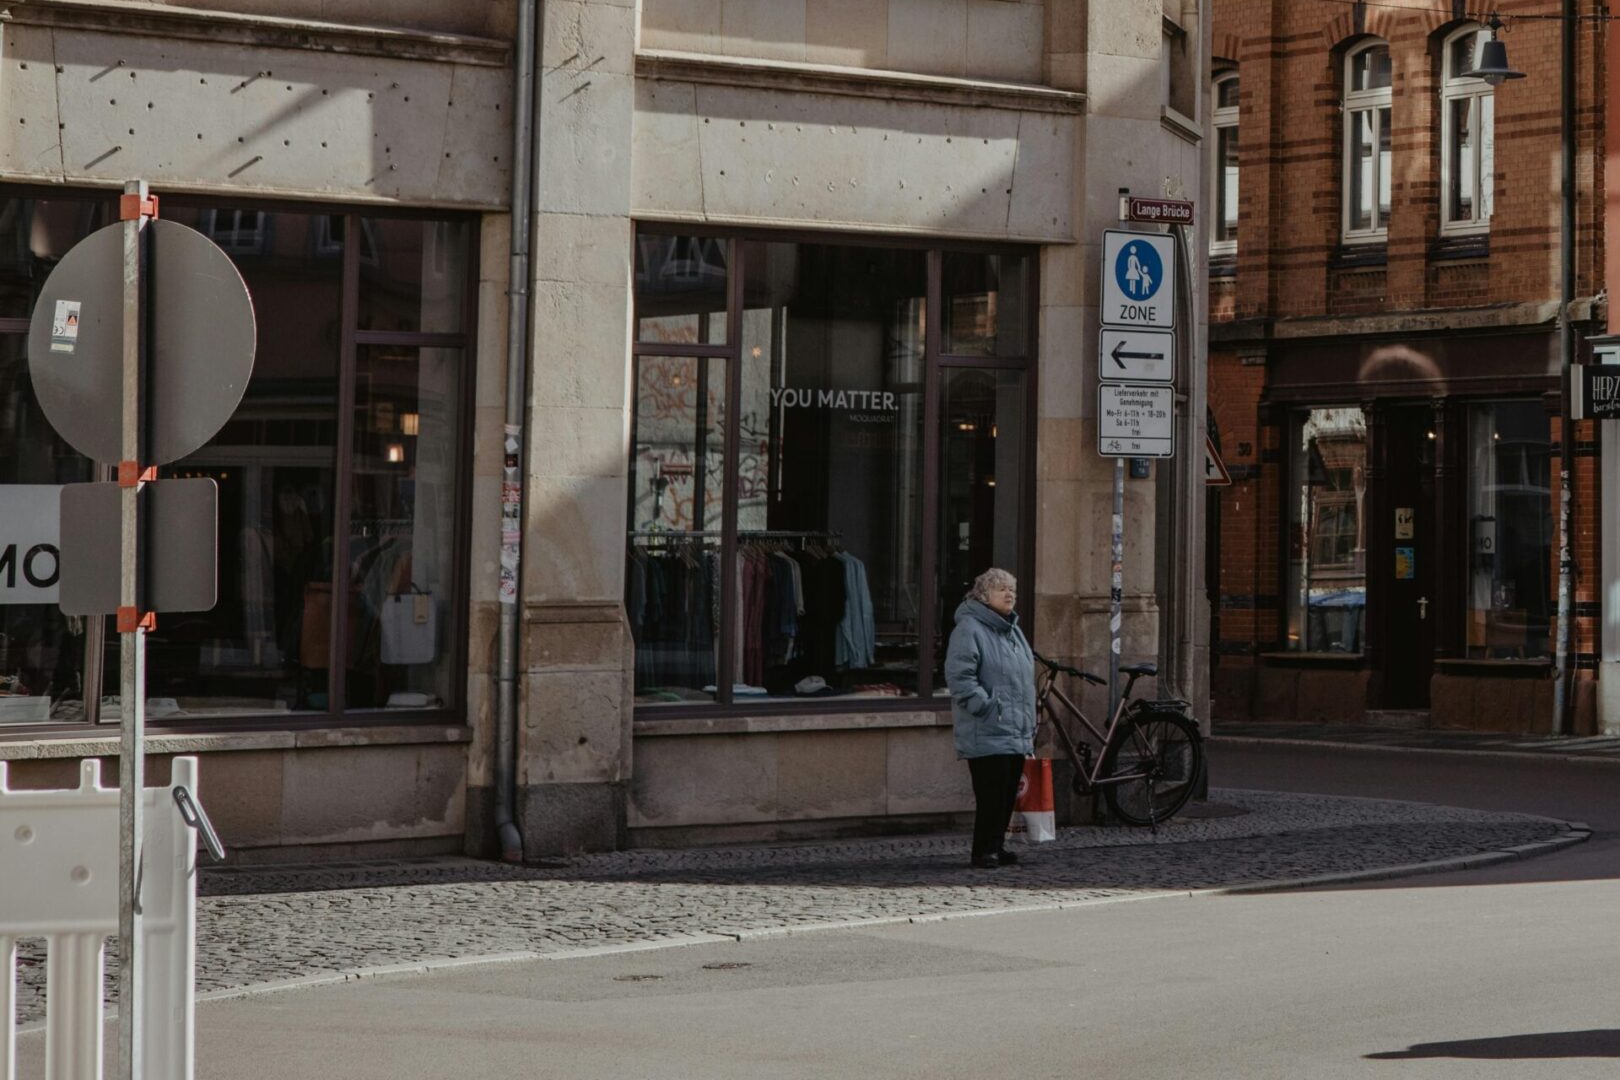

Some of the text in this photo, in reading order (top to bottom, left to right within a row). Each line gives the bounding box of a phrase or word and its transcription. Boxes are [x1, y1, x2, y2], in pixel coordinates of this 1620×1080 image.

[1137, 202, 1190, 218] Lange Brücke
[1120, 304, 1156, 321] ZONE
[1114, 389, 1159, 398] Lieferverkehr mit
[1592, 375, 1620, 400] HERZ
[771, 388, 899, 410] YOU MATTER.
[1119, 398, 1153, 408] Genehmigung
[1132, 428, 1141, 436] frei
[1131, 442, 1141, 450] frei
